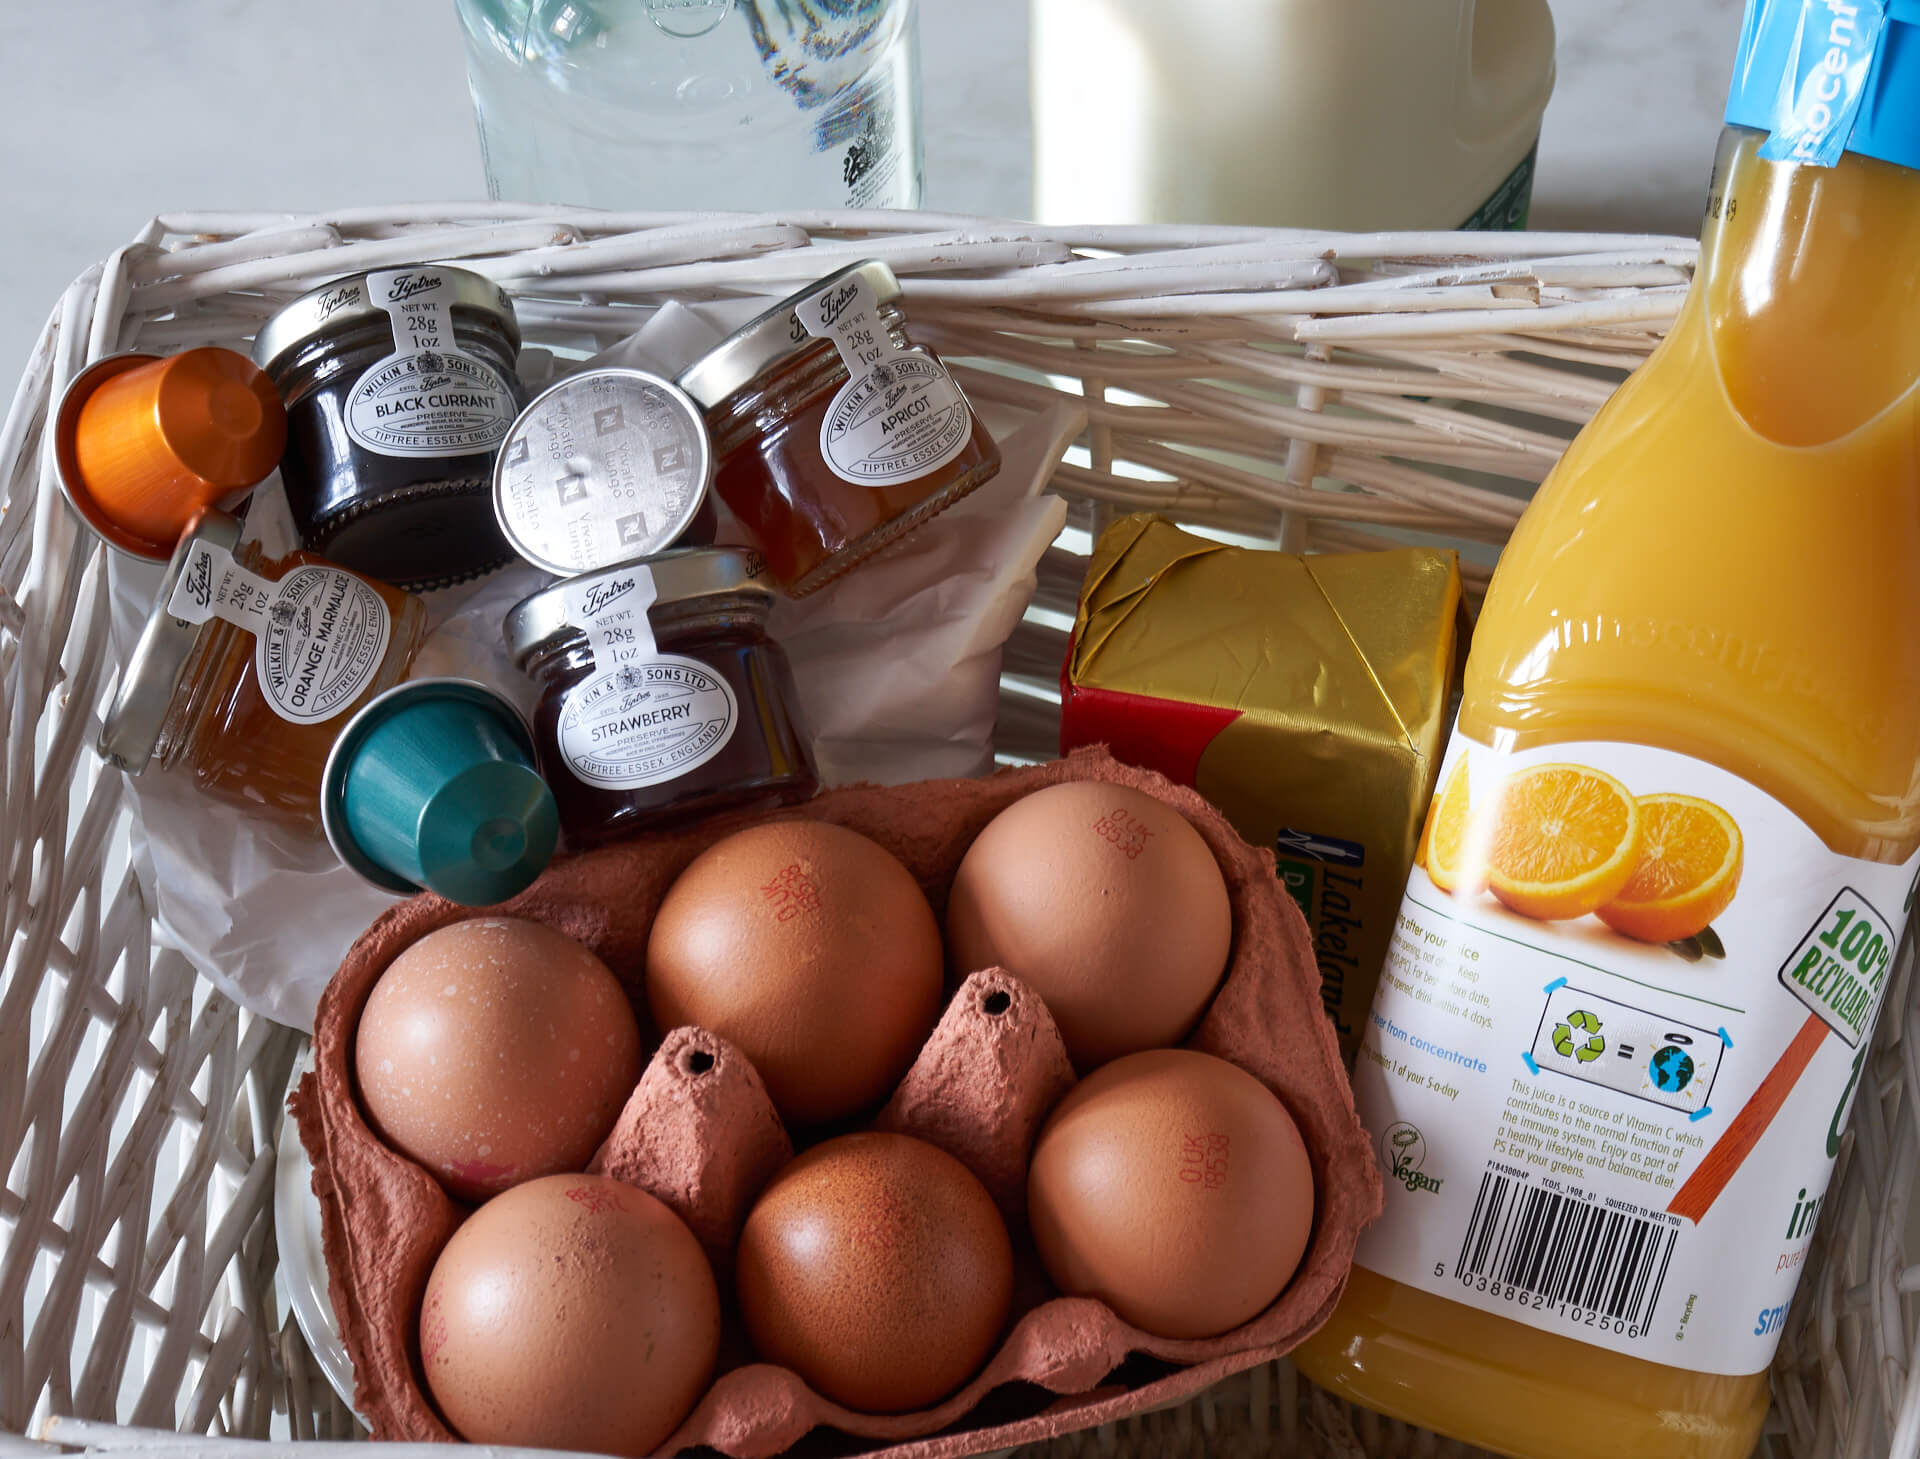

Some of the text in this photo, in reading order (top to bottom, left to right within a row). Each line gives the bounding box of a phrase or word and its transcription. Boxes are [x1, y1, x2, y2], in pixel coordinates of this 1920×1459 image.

[388, 274, 442, 302] Tiptree
[820, 283, 858, 328] Tiptree
[401, 304, 421, 313] NET
[407, 315, 437, 334] 28g
[837, 320, 852, 334] NET
[412, 335, 440, 348] 1oz
[846, 329, 874, 350] 28g
[857, 346, 883, 365] 1oz
[363, 359, 498, 398] WILKIN & SONS LTD
[834, 392, 863, 432] WILKIN
[864, 383, 874, 393] &
[895, 361, 920, 375] SONS
[921, 363, 938, 377] LTD
[376, 395, 496, 418] BLACK CURRANT
[416, 411, 469, 421] PRESERVE
[880, 395, 931, 435] APRICOT
[374, 430, 420, 445] TIPTREE
[427, 436, 464, 445] ESSEX
[469, 420, 508, 442] ENGLAND
[894, 414, 934, 441] PRESERVE
[604, 449, 622, 499] Lungo
[618, 441, 636, 498] Vivalto
[862, 458, 911, 473] TIPTREE
[913, 441, 944, 462] ESSEX
[186, 551, 212, 609] Tiptree
[216, 585, 227, 604] NET
[230, 582, 255, 610] 28g
[287, 578, 309, 601] SONS
[582, 577, 636, 617] Tiptree
[249, 591, 270, 616] 1oz
[595, 617, 613, 628] NET
[273, 629, 285, 637] &
[291, 642, 326, 707] ORANGE
[315, 574, 350, 642] MARMALADE
[331, 616, 349, 655] FINE CUT
[603, 626, 636, 646] 28g
[270, 643, 285, 688] WILKIN
[321, 667, 359, 704] TIPTREE
[357, 632, 377, 665] ESSEX
[612, 647, 638, 663] 1oz
[569, 688, 601, 722] WILKIN
[606, 681, 614, 691] &
[647, 669, 681, 681] SONS
[684, 672, 706, 689] LTD
[592, 703, 692, 742] STRAWBERRY
[617, 727, 669, 746] PRESERVE
[582, 759, 623, 775] TIPTREE
[628, 756, 665, 774] ESSEX
[671, 724, 719, 762] ENGLAND
[1405, 919, 1424, 937] after
[1424, 930, 1448, 948] your
[1819, 909, 1889, 994] 100%
[1791, 945, 1874, 1036] RECYCLABLE
[1461, 1007, 1469, 1019] 4
[1387, 1020, 1488, 1073] from concentrate
[1392, 1060, 1398, 1073] 1
[1398, 1064, 1408, 1077] of
[1406, 1070, 1425, 1086] your
[1426, 1076, 1460, 1101] 5-a-day
[1506, 1096, 1685, 1159] contributes to the normal function of
[1511, 1079, 1704, 1149] This juice is a source of Vitamin C which
[1493, 1138, 1585, 1179] PS Eat your greens.
[1497, 1126, 1676, 1190] a healthy lifestyle and balanced diet.
[1502, 1109, 1679, 1174] the immune system. Enjoy as part of
[1389, 1149, 1442, 1195] Vegan
[1604, 1197, 1638, 1215] SQUEEZED
[1639, 1207, 1648, 1217] TO
[1649, 1210, 1667, 1222] MEET
[1668, 1215, 1682, 1227] YOU
[1433, 1262, 1639, 1340] 5 038862 102506
